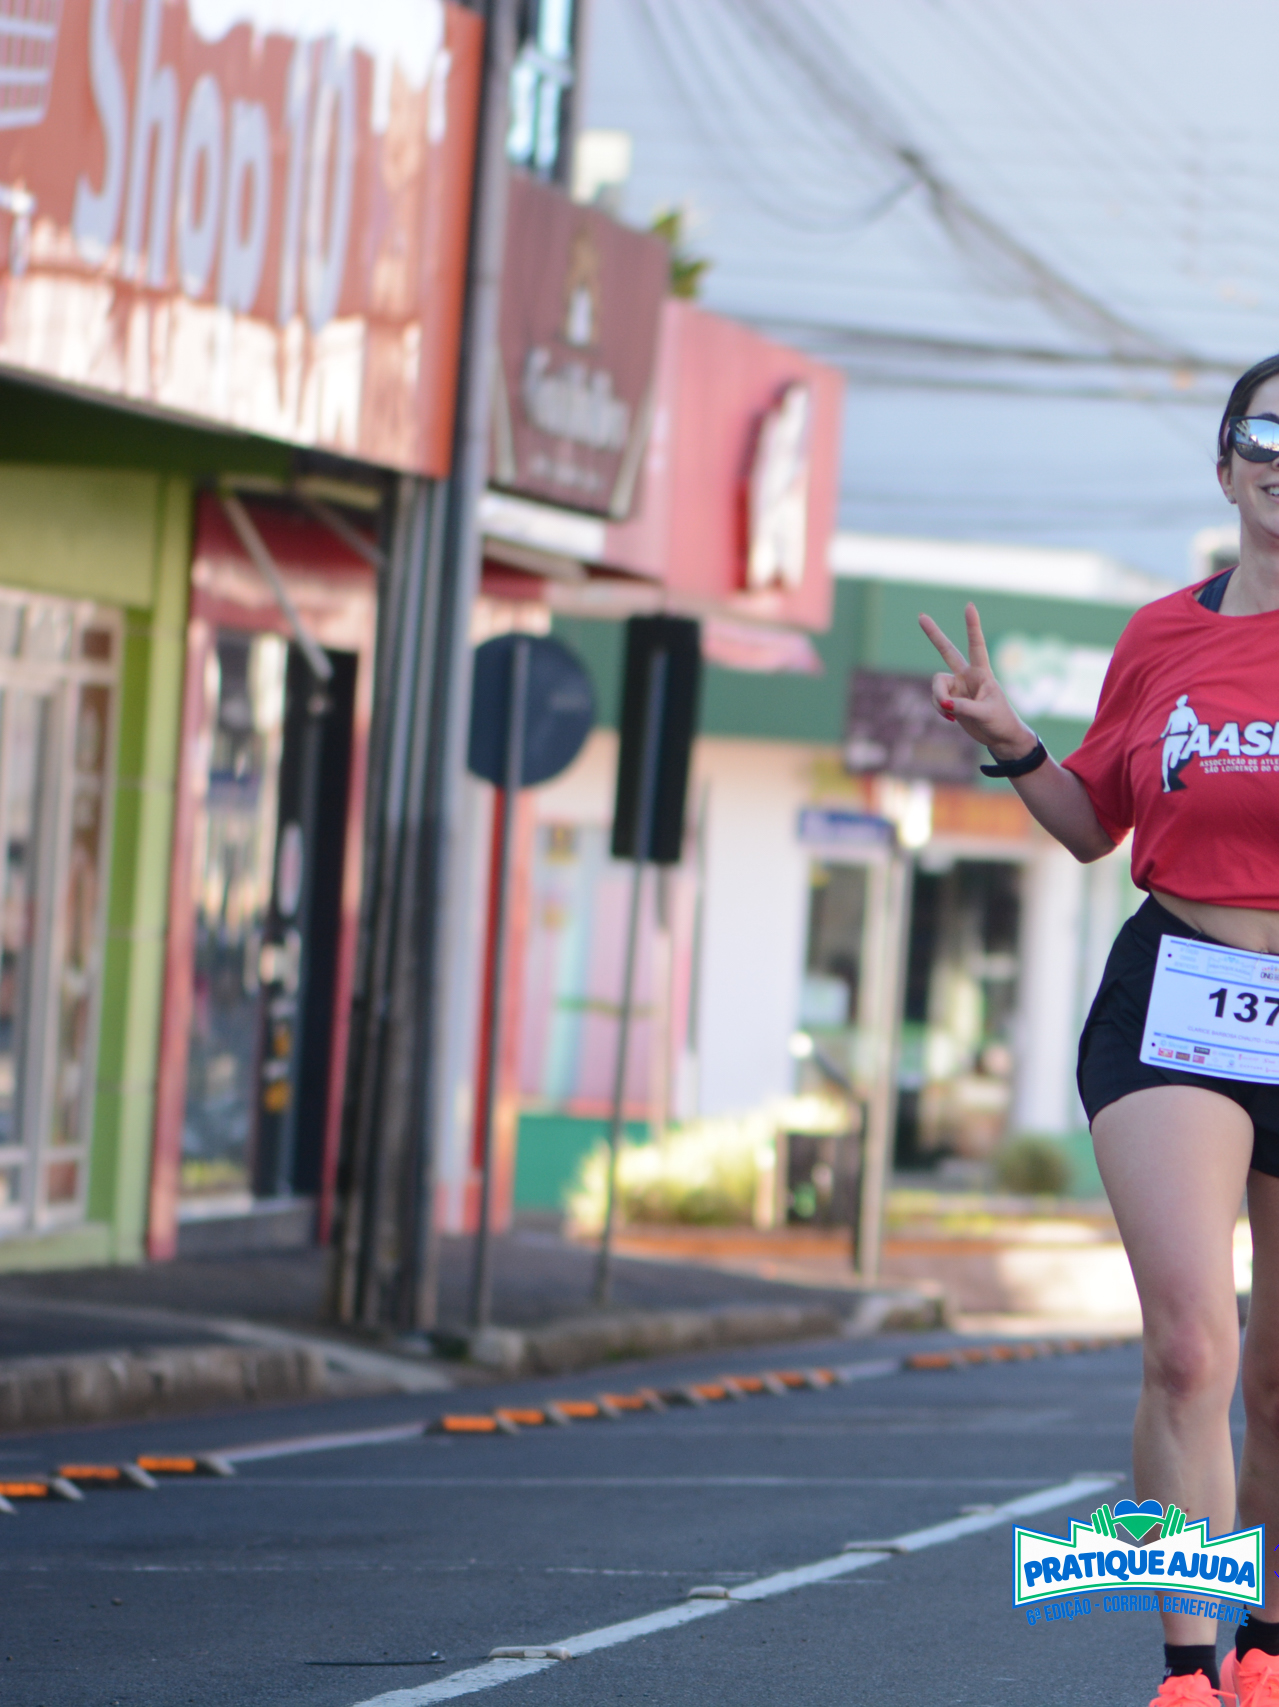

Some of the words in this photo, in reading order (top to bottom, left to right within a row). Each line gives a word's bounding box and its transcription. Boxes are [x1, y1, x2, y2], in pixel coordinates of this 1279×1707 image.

[72, 0, 271, 317] Shop
[277, 35, 358, 337] 10
[1199, 758, 1246, 767] ASSOCIAÇÃO
[1248, 758, 1258, 766] DE
[1204, 765, 1219, 774] SÃO
[1221, 765, 1259, 773] LOURENÇO
